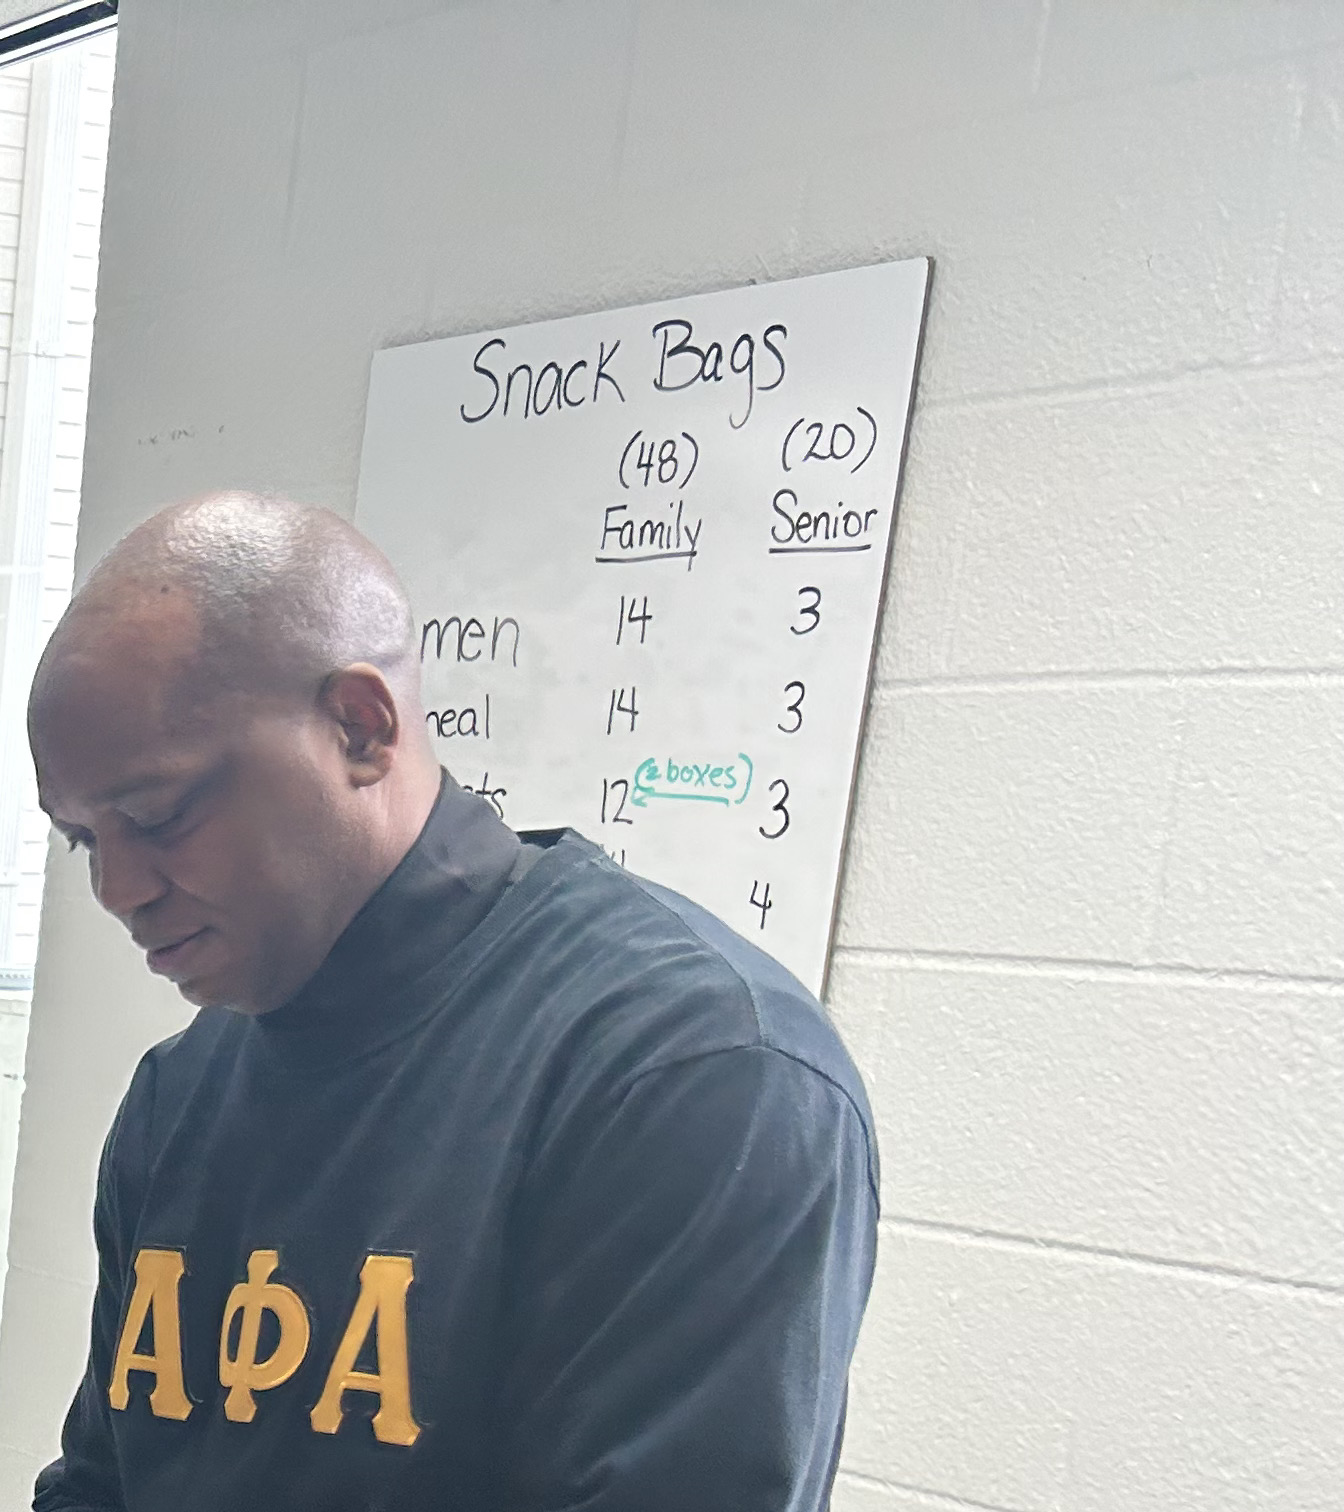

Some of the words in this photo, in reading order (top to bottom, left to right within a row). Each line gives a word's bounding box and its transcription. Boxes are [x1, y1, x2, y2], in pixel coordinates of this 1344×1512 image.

[461, 338, 626, 423] Snack
[652, 319, 788, 429] Bags
[618, 430, 700, 490] (48)
[782, 406, 878, 475] (20)
[601, 500, 702, 571] Family
[770, 488, 878, 543] Senior
[615, 595, 653, 646] 14
[789, 586, 823, 635] 3
[607, 686, 639, 735] 14
[777, 681, 807, 734] 3
[600, 778, 633, 825] 12
[759, 779, 790, 839] 3
[749, 880, 772, 929] 4
